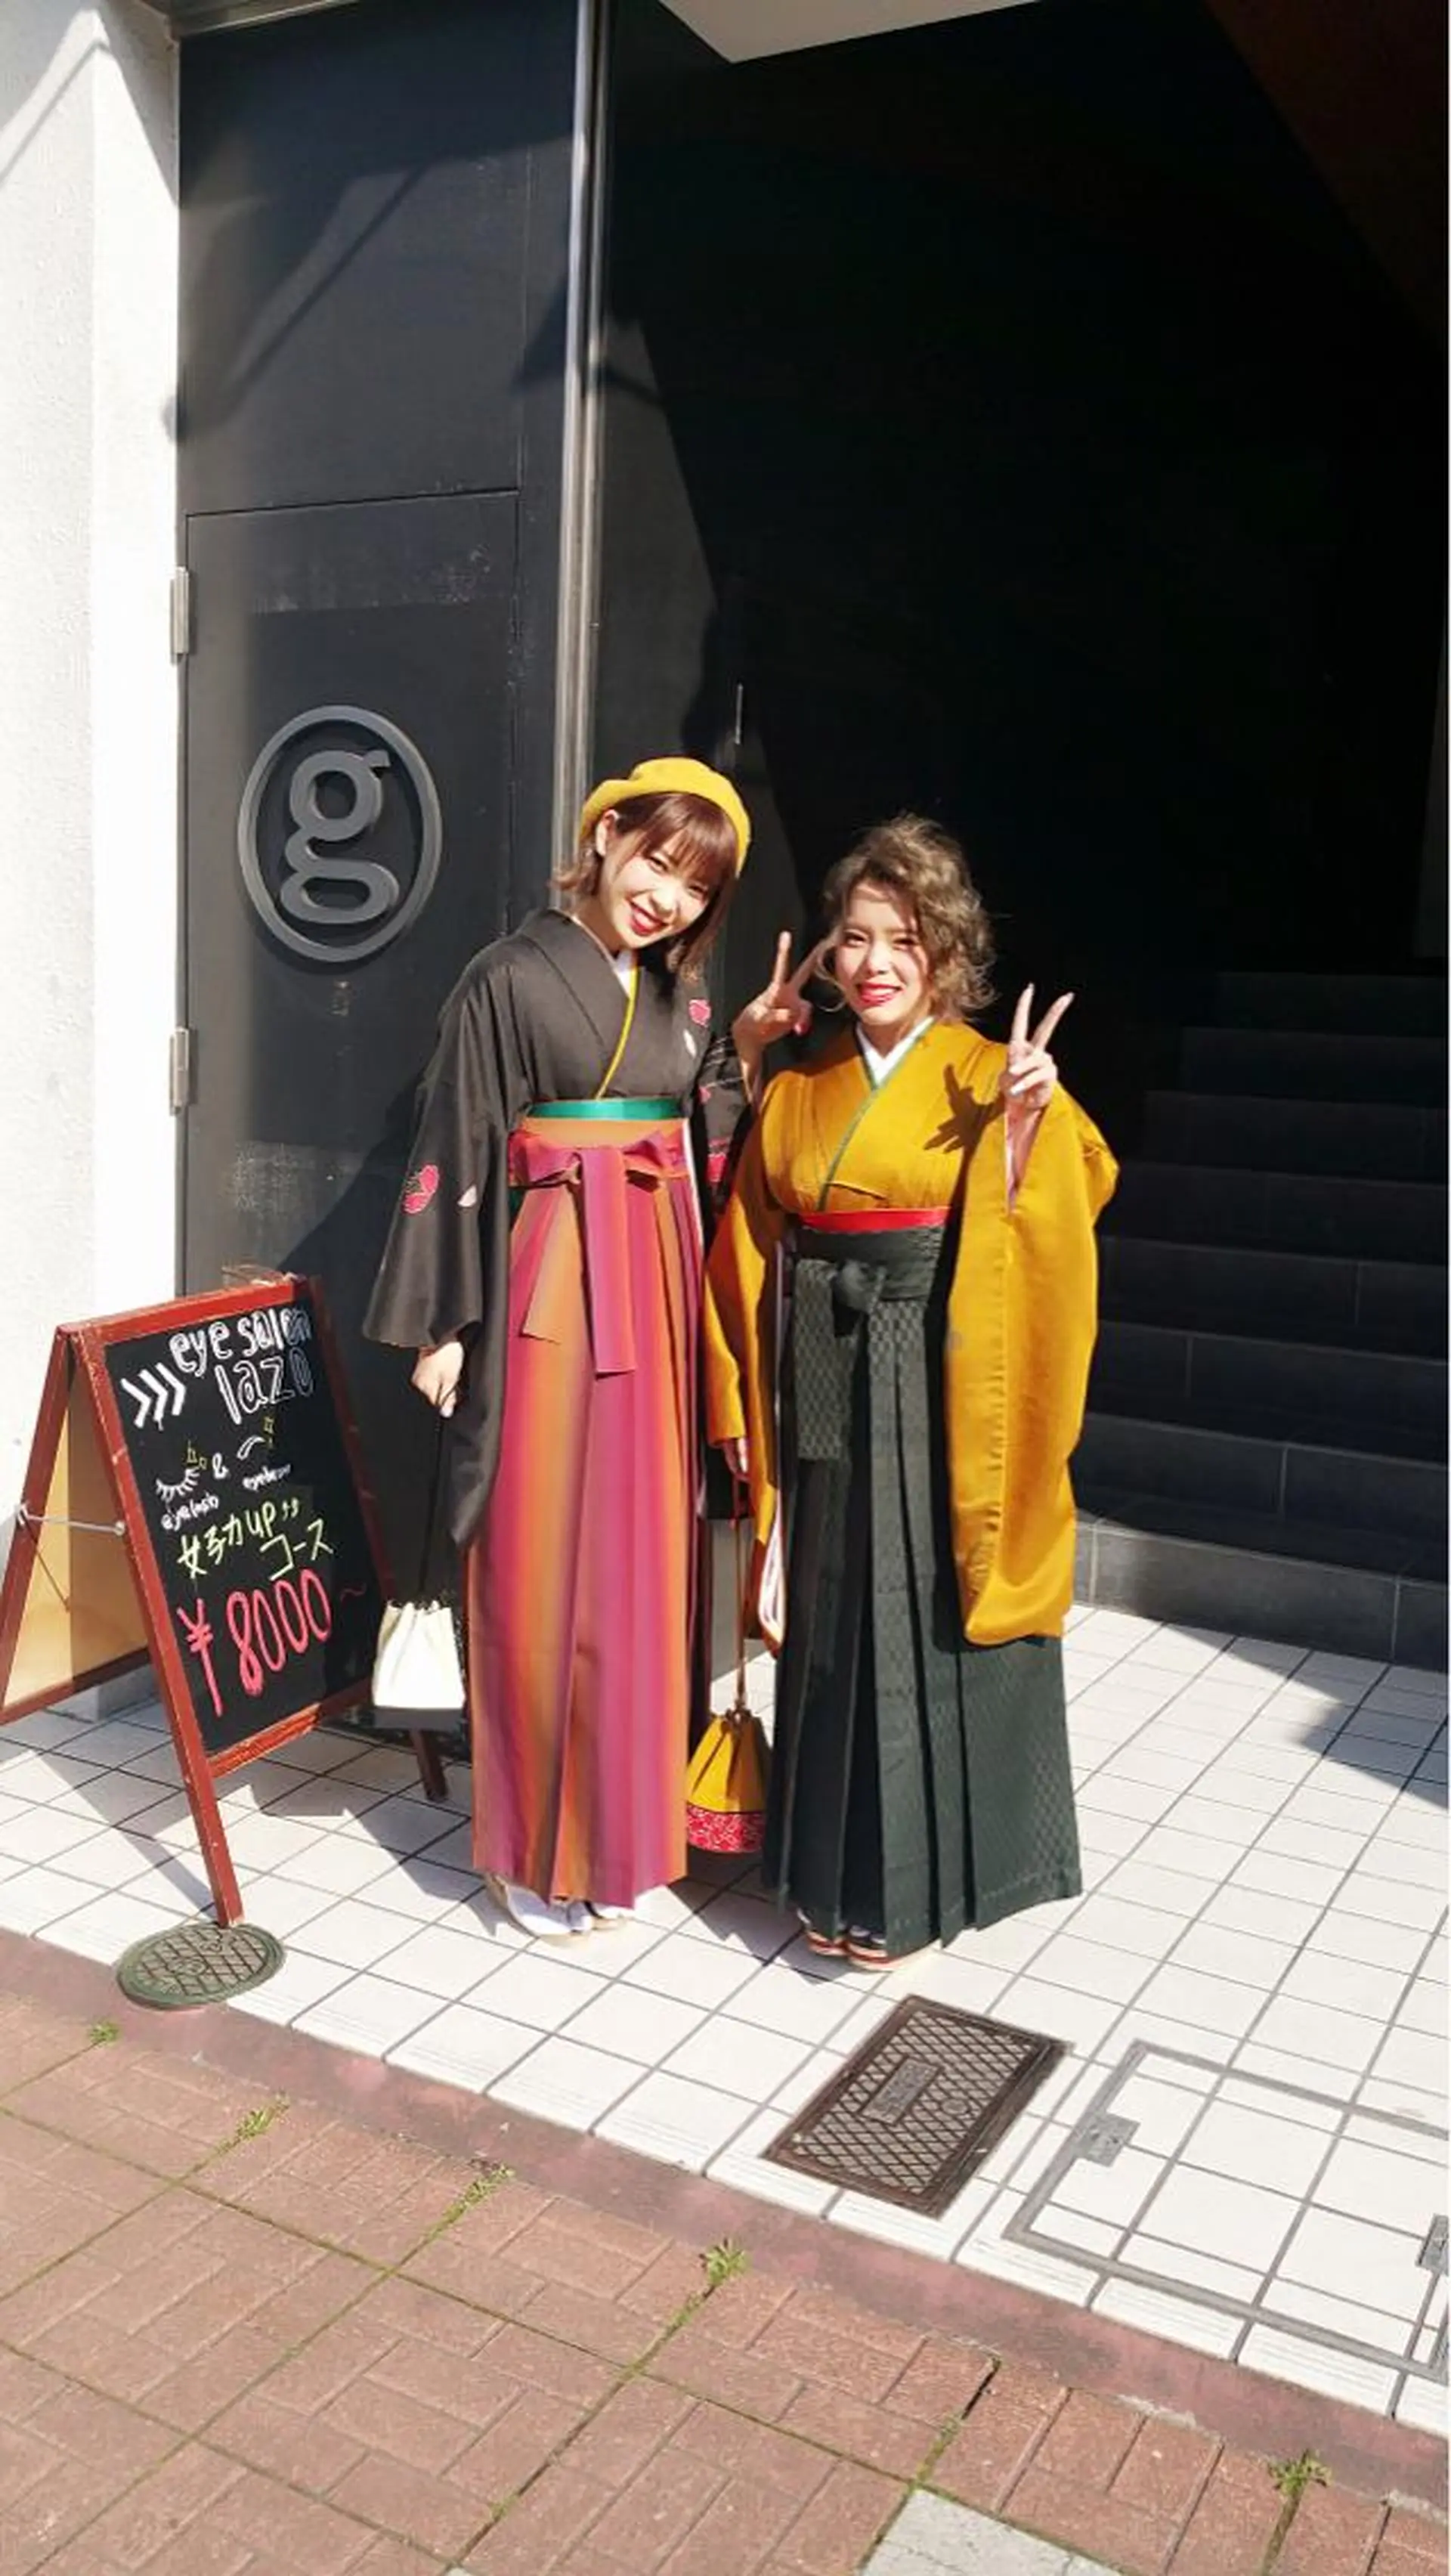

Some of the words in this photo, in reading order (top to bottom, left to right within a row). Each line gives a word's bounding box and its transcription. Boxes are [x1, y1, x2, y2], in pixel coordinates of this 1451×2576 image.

[280, 750, 401, 924] g
[169, 1321, 234, 1377] eye
[237, 1308, 311, 1357] salon
[215, 1346, 314, 1425] lazo
[259, 1518, 335, 1581] コース
